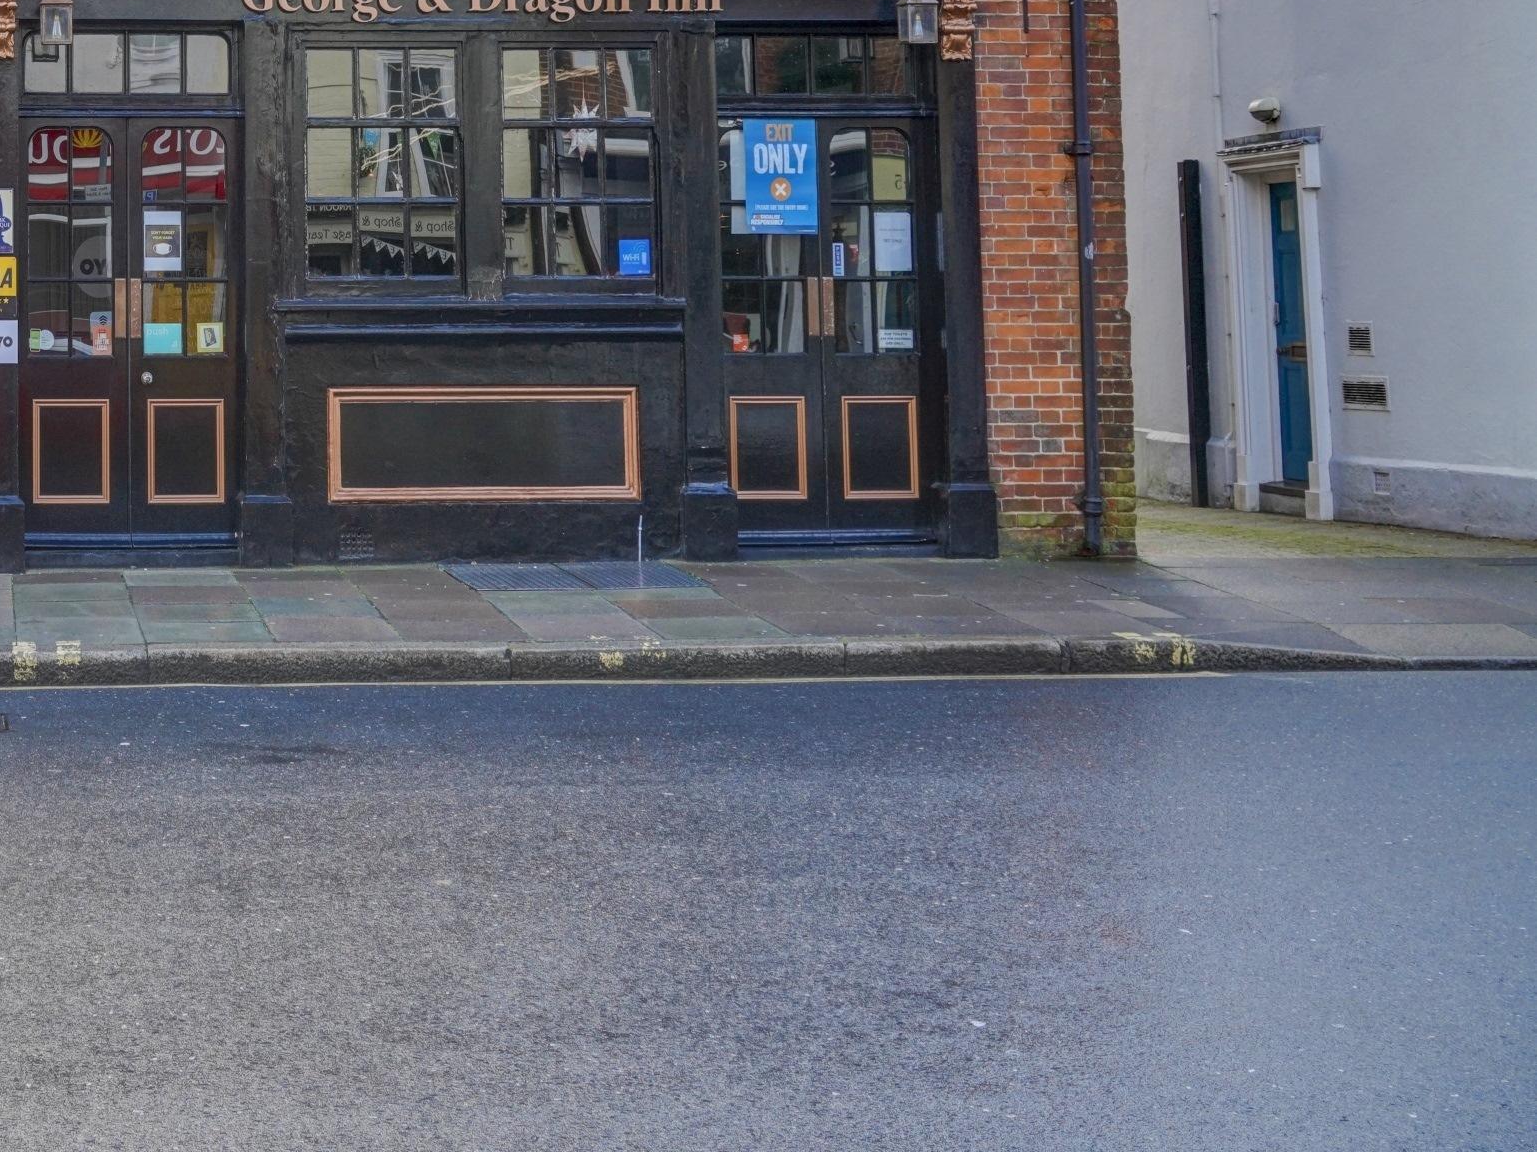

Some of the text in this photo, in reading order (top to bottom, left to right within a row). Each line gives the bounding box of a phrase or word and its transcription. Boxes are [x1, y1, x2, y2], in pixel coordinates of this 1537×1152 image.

[766, 124, 794, 141] EXIT
[753, 142, 808, 174] ONLY
[79, 258, 107, 275] OY
[145, 326, 169, 337] push
